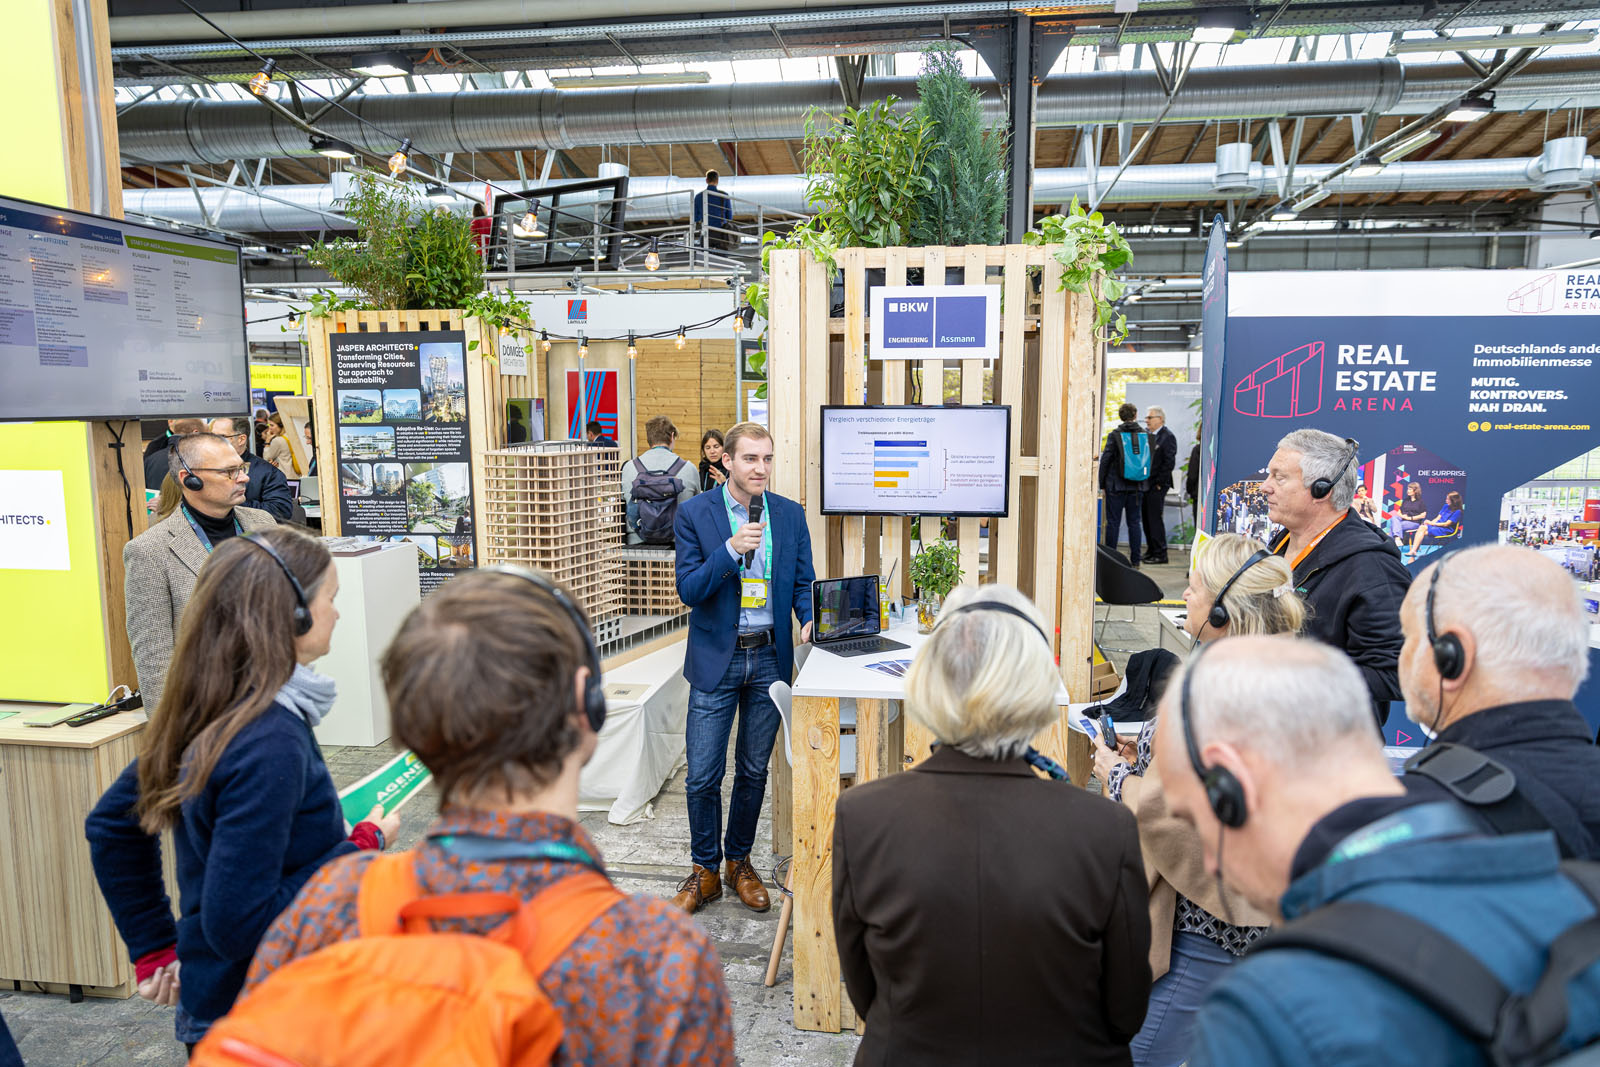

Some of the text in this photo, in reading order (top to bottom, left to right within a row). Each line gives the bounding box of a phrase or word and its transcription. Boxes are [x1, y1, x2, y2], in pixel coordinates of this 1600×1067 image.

[900, 302, 928, 312] BKW
[1474, 344, 1566, 354] Deutschlands
[1338, 344, 1409, 365] REAL
[1473, 357, 1592, 367] Immobilienmesse
[338, 376, 387, 384] Sustainability.
[1336, 371, 1437, 391] ESTATE
[1471, 377, 1520, 386] MUTIG.
[1470, 390, 1568, 400] KONTROVERS.
[1333, 398, 1413, 411] ARENA
[1469, 403, 1547, 412] NAH DRAN.
[0, 515, 44, 525] HITECTS
